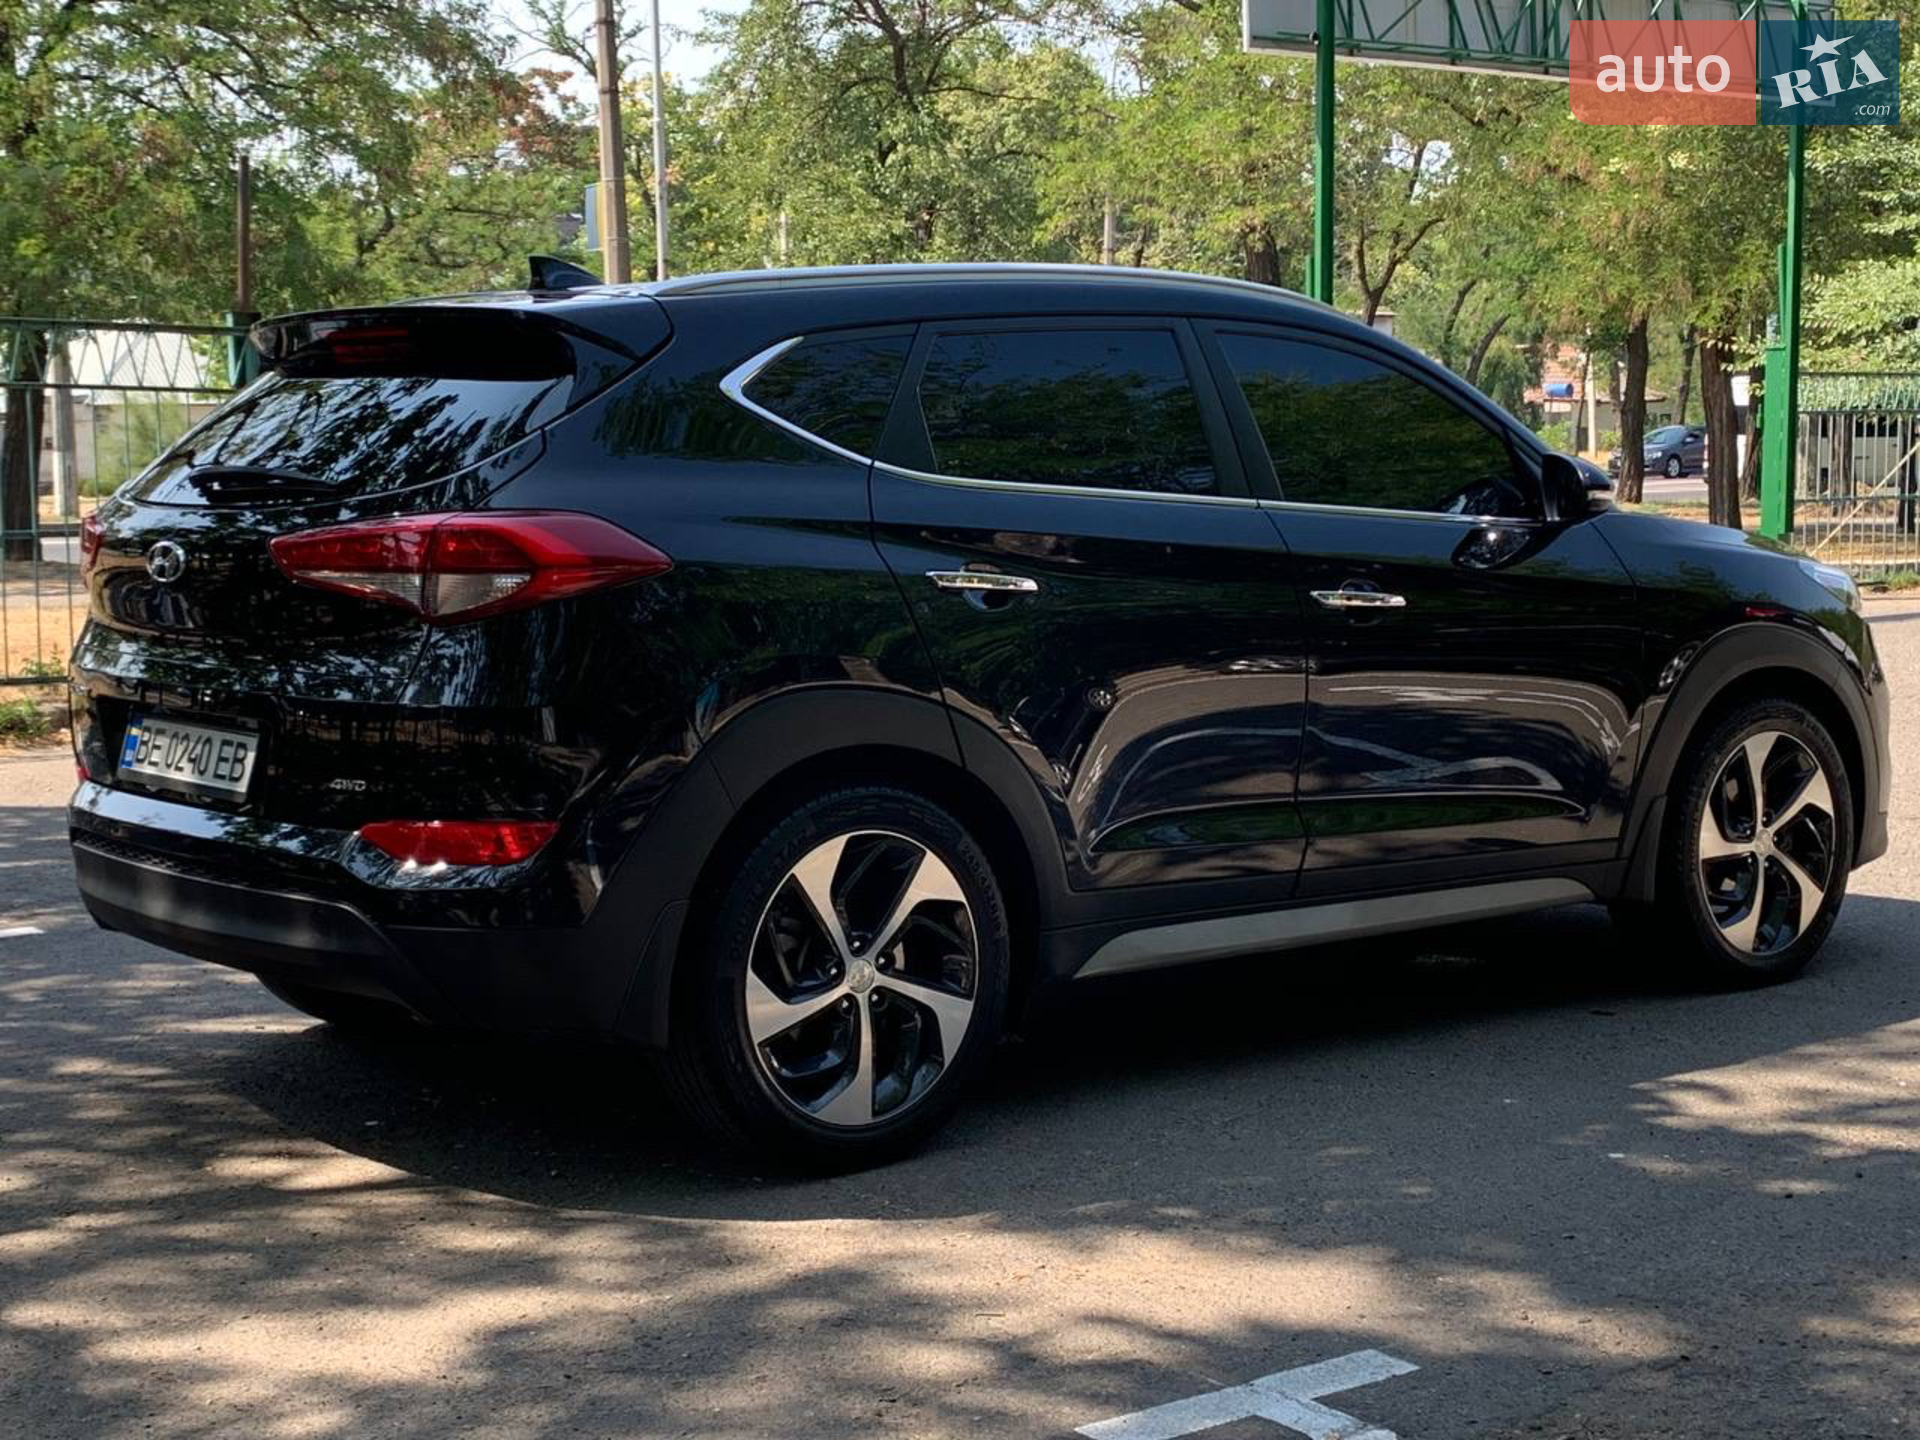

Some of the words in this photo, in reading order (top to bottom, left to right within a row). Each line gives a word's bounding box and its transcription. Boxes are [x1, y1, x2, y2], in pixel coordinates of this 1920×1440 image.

[136, 726, 166, 767] BE
[165, 731, 212, 776] 0240
[213, 739, 248, 783] EB
[329, 778, 366, 791] 4WD
